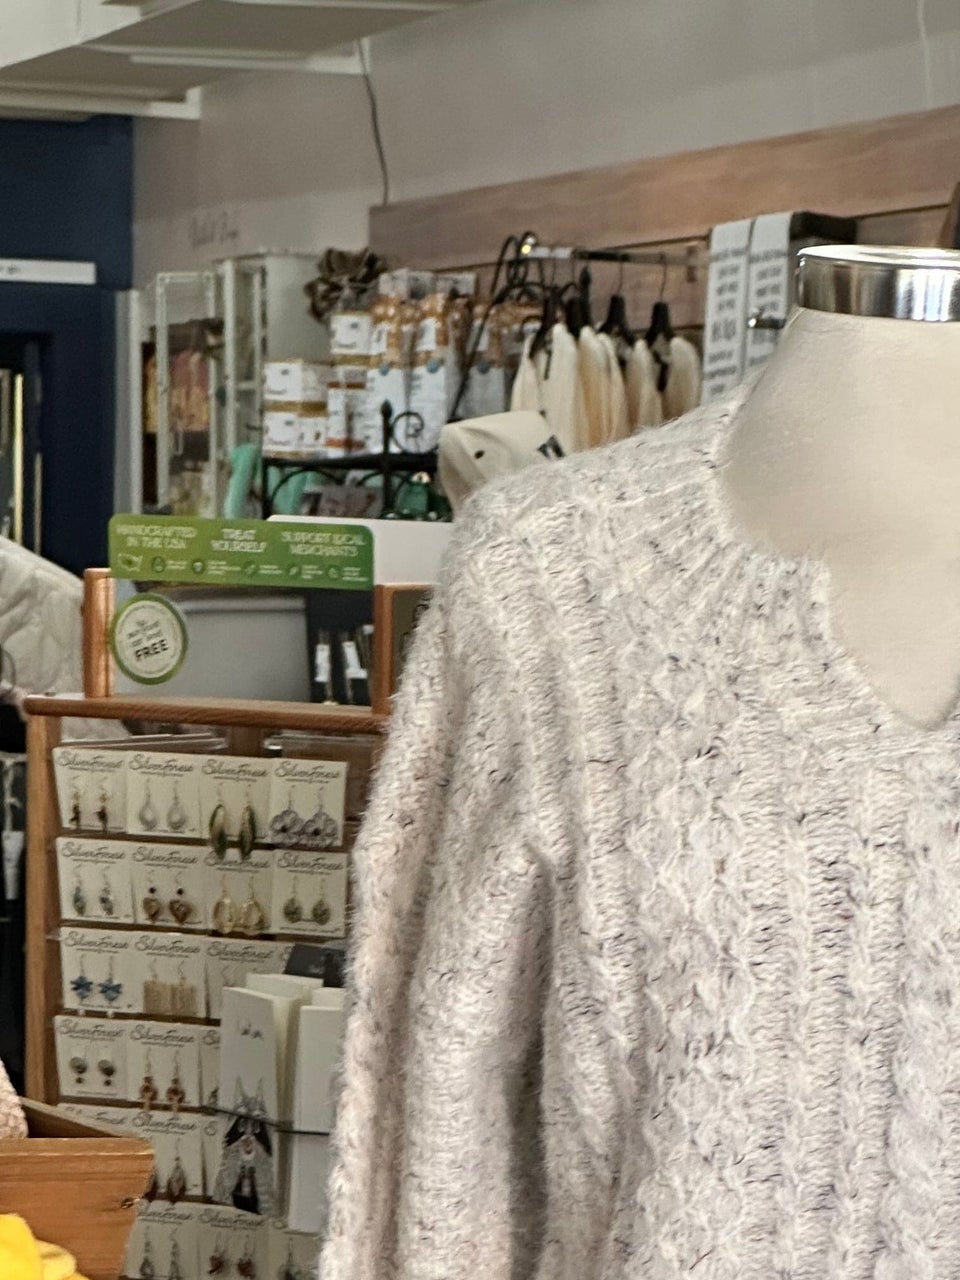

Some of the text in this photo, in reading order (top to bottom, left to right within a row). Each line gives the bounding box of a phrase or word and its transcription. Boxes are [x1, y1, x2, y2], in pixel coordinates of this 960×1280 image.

[222, 528, 256, 540] TREAT
[281, 531, 331, 543] SUPPORT
[126, 536, 186, 549] IN THE USA
[210, 540, 267, 552] YOURSELF
[289, 544, 359, 557] MERCHANTS
[135, 638, 169, 661] FREE
